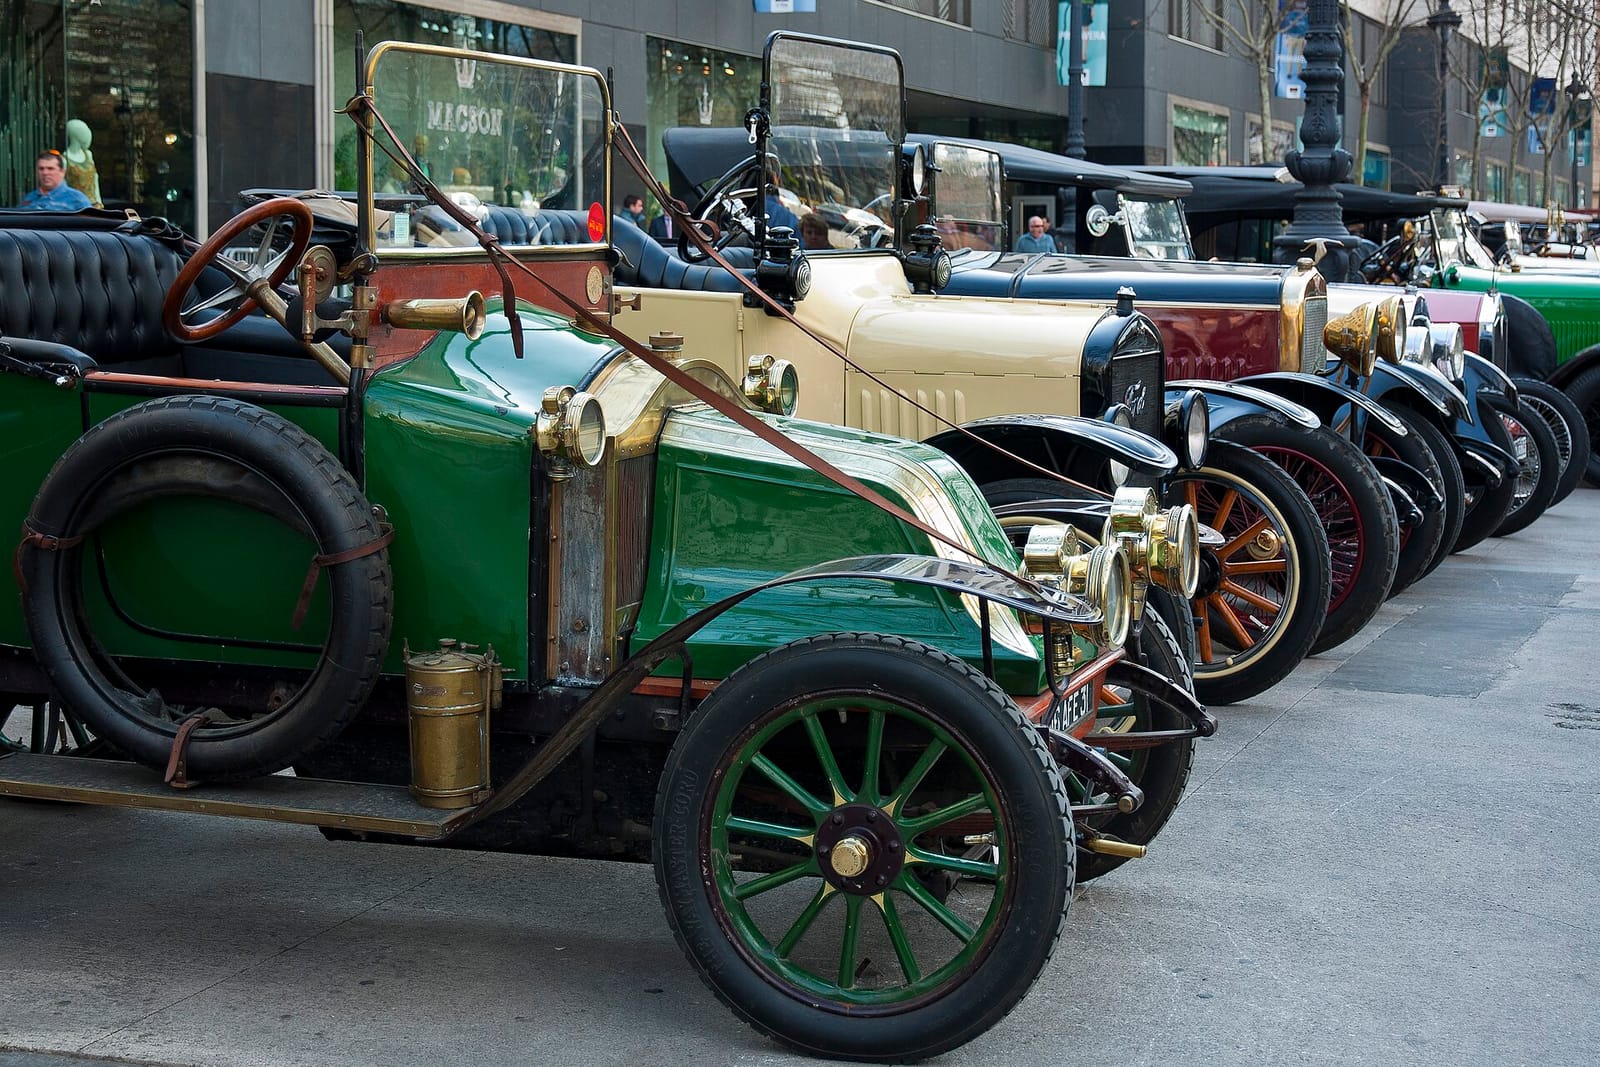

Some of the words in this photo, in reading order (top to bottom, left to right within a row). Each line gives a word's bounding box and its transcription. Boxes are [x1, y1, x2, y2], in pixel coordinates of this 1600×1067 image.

[427, 100, 503, 136] MACSON
[127, 418, 234, 442] MICHELN
[1062, 691, 1079, 731] AFE
